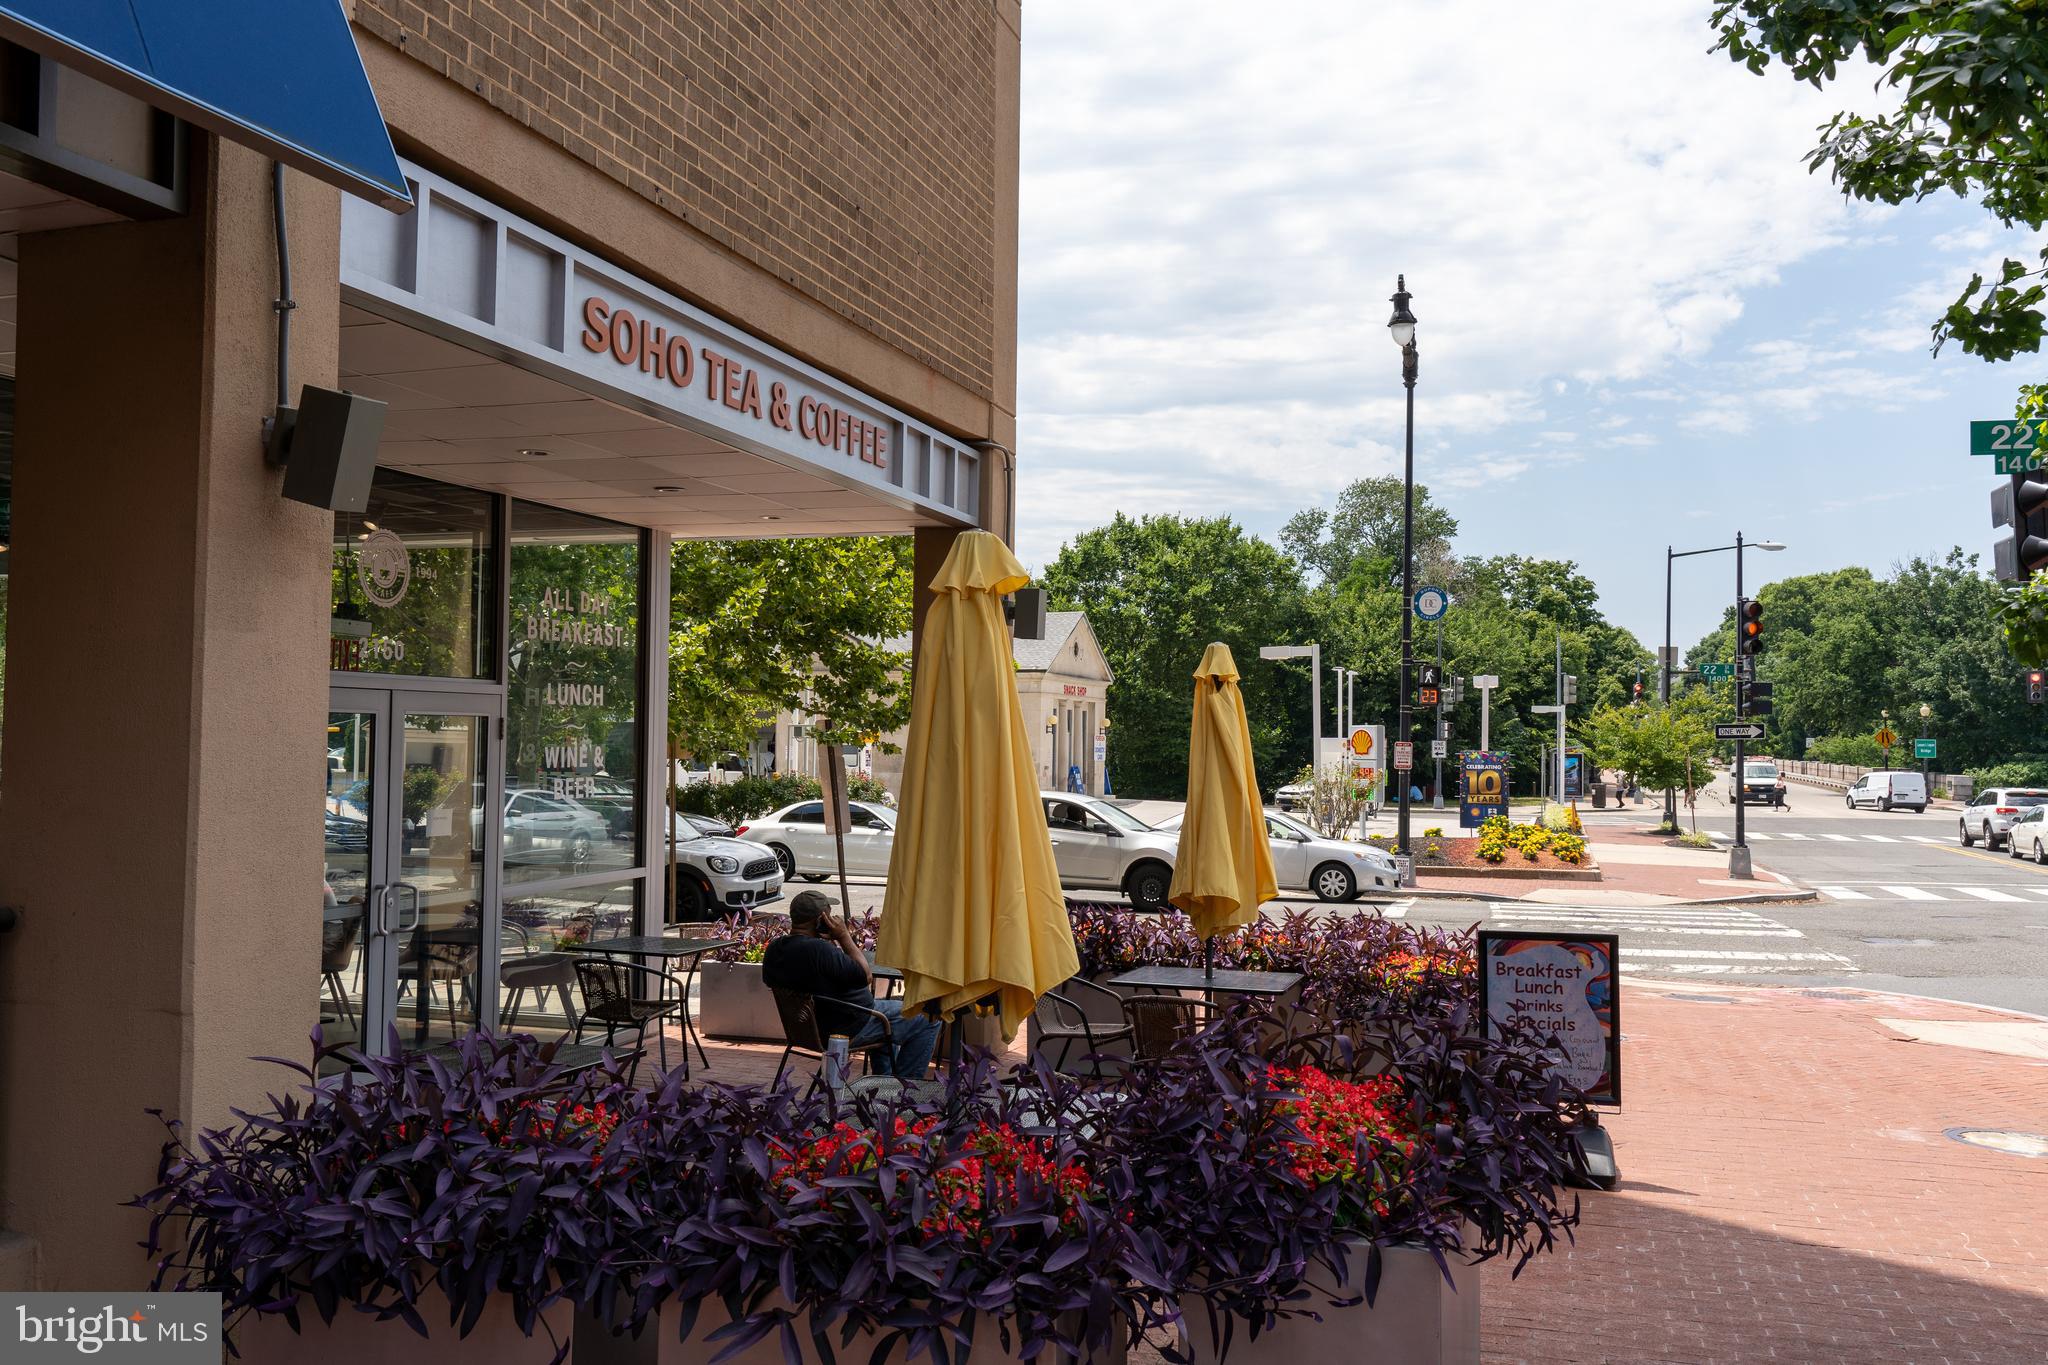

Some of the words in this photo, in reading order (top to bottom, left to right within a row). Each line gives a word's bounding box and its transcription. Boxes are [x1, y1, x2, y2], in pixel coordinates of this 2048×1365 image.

[582, 295, 694, 388] SOHO
[703, 347, 763, 419] TEA
[771, 381, 793, 431] &
[798, 394, 888, 468] COFFEE
[1991, 424, 2033, 450] 22
[1998, 455, 2048, 472] 140
[415, 566, 438, 580] 1994
[543, 586, 574, 612] ALL
[580, 590, 612, 616] DAY
[527, 616, 624, 647] BREAKFAST
[359, 637, 405, 661] 2150
[1703, 665, 1717, 674] 22
[546, 682, 605, 707] LUNCH
[1422, 689, 1438, 703] 23
[545, 745, 588, 769] WINE
[594, 745, 604, 768] &
[553, 776, 595, 801] BEER
[1466, 770, 1502, 795] 10
[1496, 961, 1583, 980] Breakfast
[1514, 978, 1564, 996] Lunch
